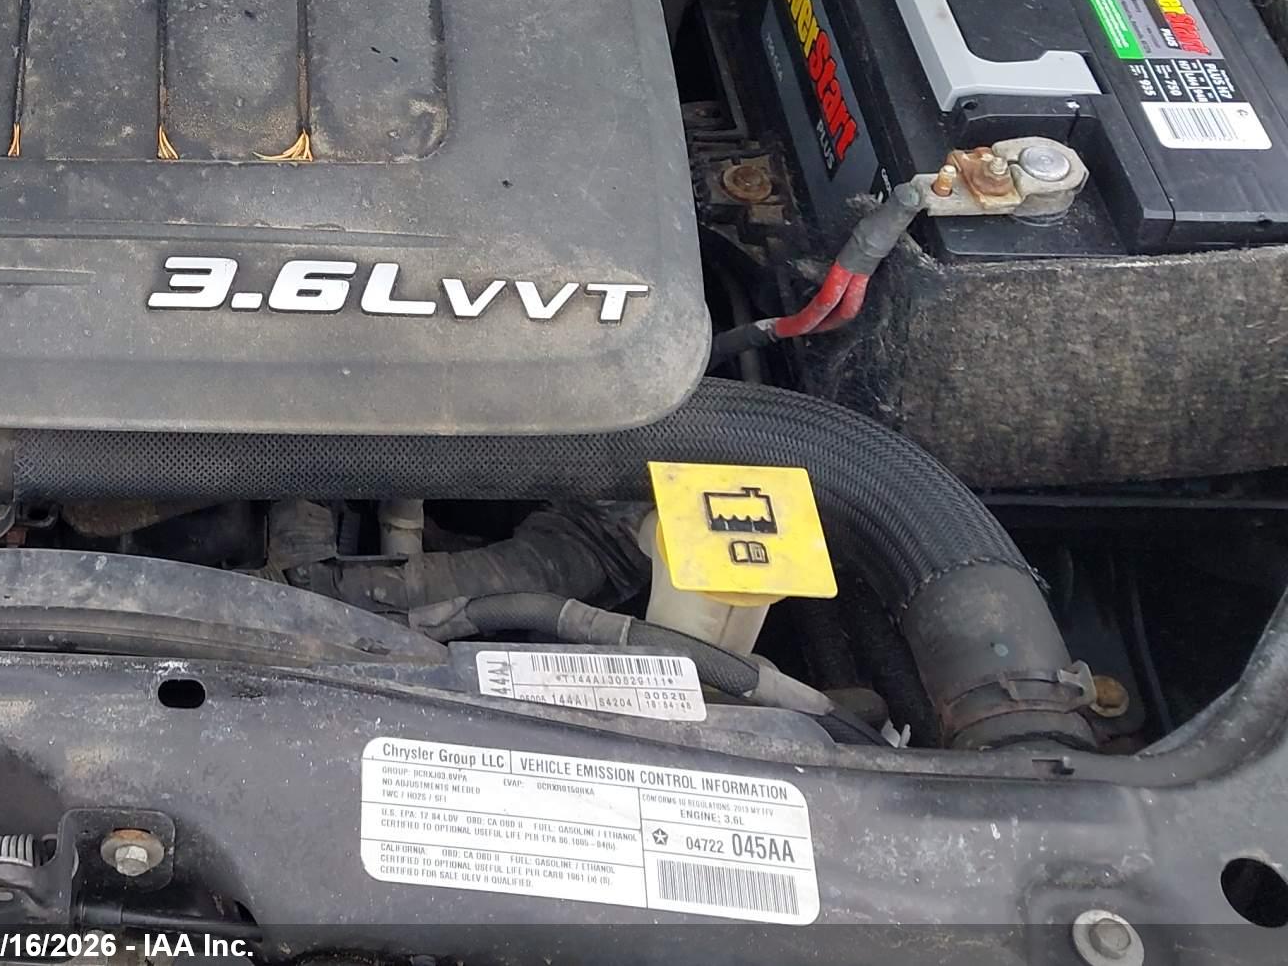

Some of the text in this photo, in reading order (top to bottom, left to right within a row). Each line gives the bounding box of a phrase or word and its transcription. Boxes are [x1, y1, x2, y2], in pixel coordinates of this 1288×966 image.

[816, 118, 835, 170] PLUS
[147, 256, 650, 323] 3.6L VVT
[382, 743, 505, 769] Chrysler Group LLC
[382, 777, 481, 795] NO ADJUSTMENTS NEEDED
[520, 757, 788, 801] VEHICLE EMISSION CONTROL INFORMATION
[680, 809, 745, 825] ENGINE: 3.6L
[381, 818, 419, 830] CERTIFIED
[434, 823, 471, 835] OPTIONAL
[474, 827, 503, 838] USEFUL
[505, 831, 521, 840] LIFE
[525, 833, 539, 842] PER
[487, 818, 497, 827] CA
[558, 825, 595, 837] GASOLINE
[604, 831, 637, 842] ETHANOL
[686, 833, 795, 863] 04722 045AA
[380, 854, 419, 866] CERTIFIED
[434, 859, 471, 871] OPTIONAL
[475, 863, 503, 874] USEFUL
[506, 866, 522, 875] LIFE
[525, 868, 540, 877] PER
[380, 865, 419, 877] CERTIFIED
[421, 870, 437, 878] FOR
[440, 871, 457, 880] SALE
[463, 851, 473, 859] CA
[535, 858, 572, 869] GASOLINE
[581, 863, 616, 874] ETHANOL
